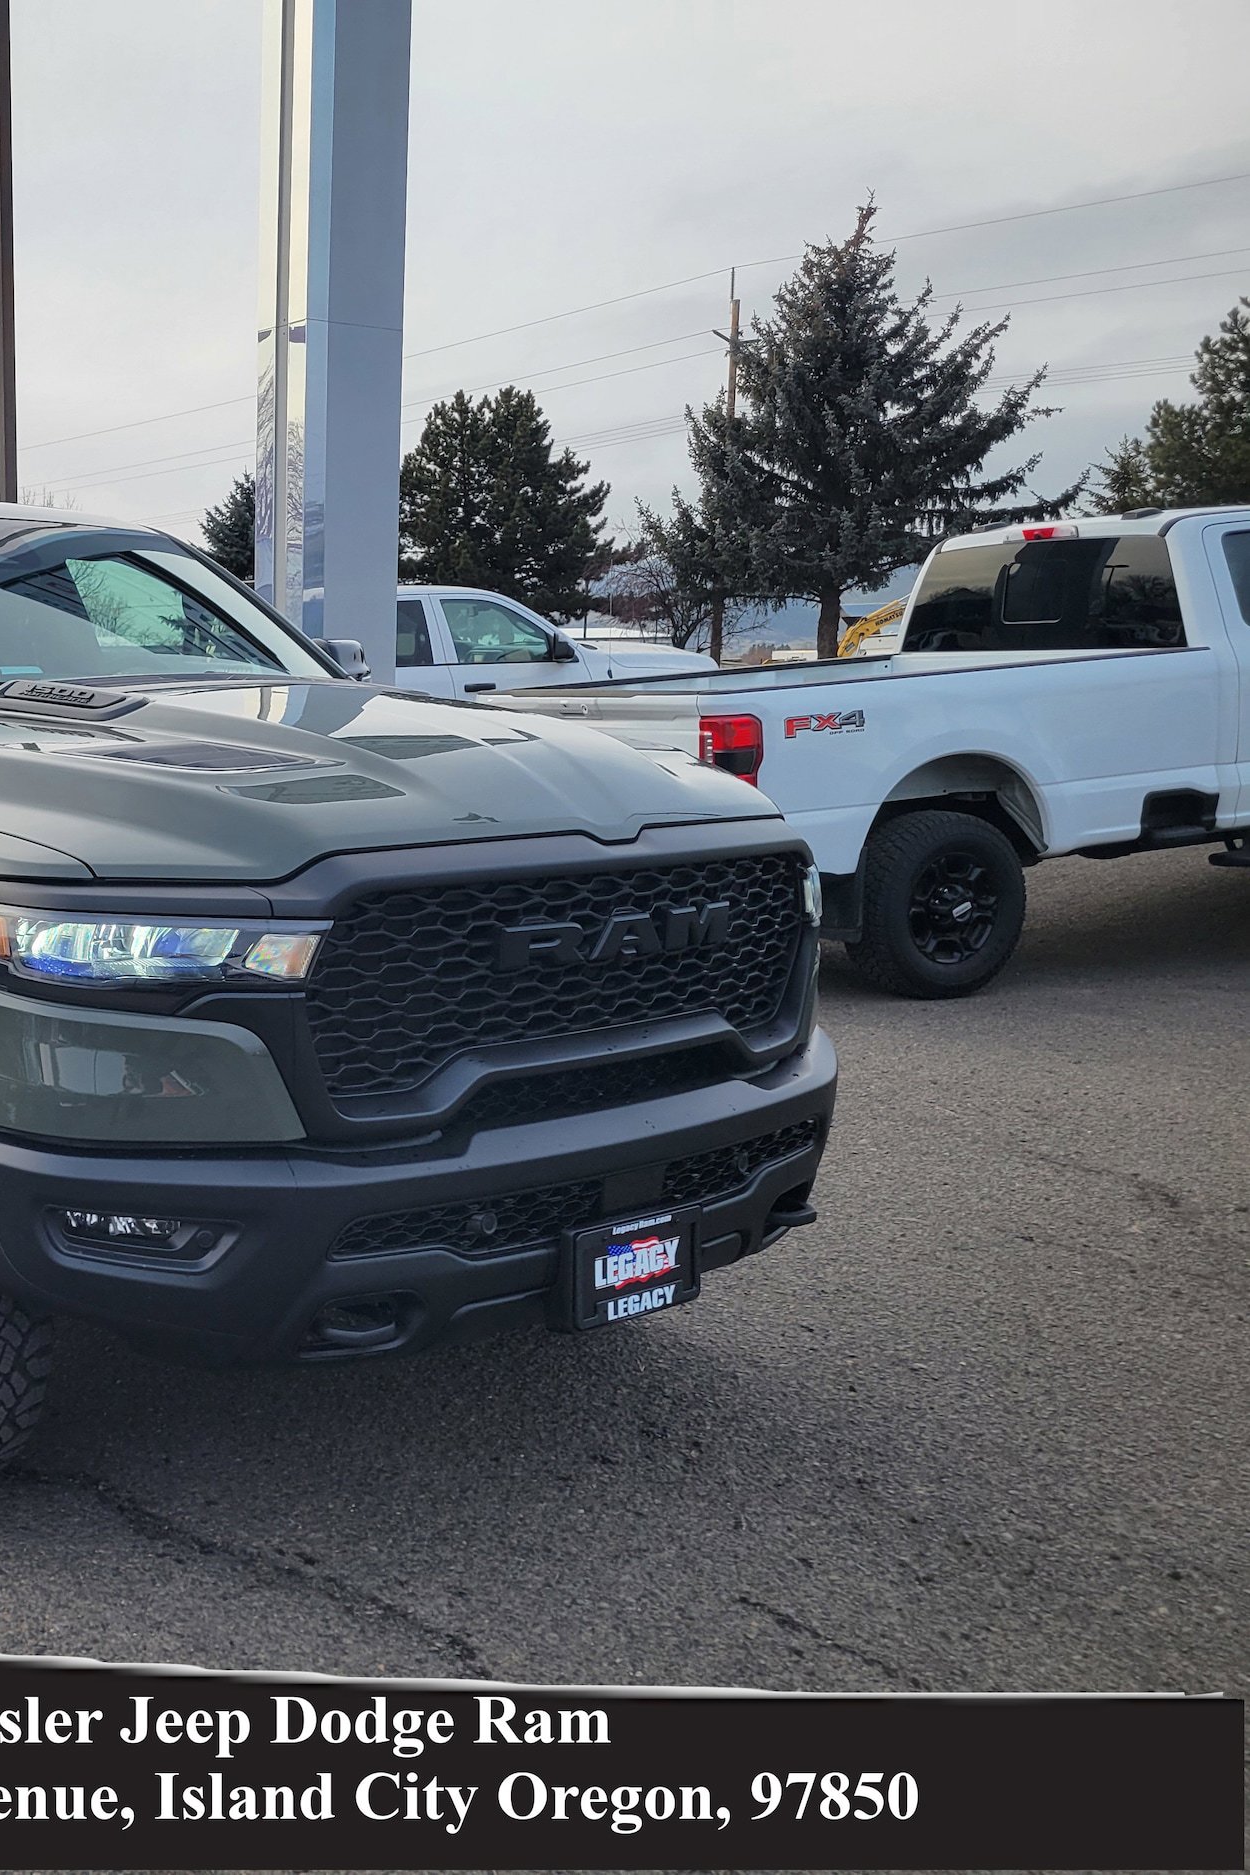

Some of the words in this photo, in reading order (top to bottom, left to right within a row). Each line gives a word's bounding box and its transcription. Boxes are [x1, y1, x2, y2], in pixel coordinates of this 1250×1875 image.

[874, 611, 903, 626] KOMATSU
[784, 709, 865, 739] FX4
[497, 901, 730, 970] RAM
[594, 1238, 680, 1289] LEGACY
[607, 1285, 676, 1321] LEGACY
